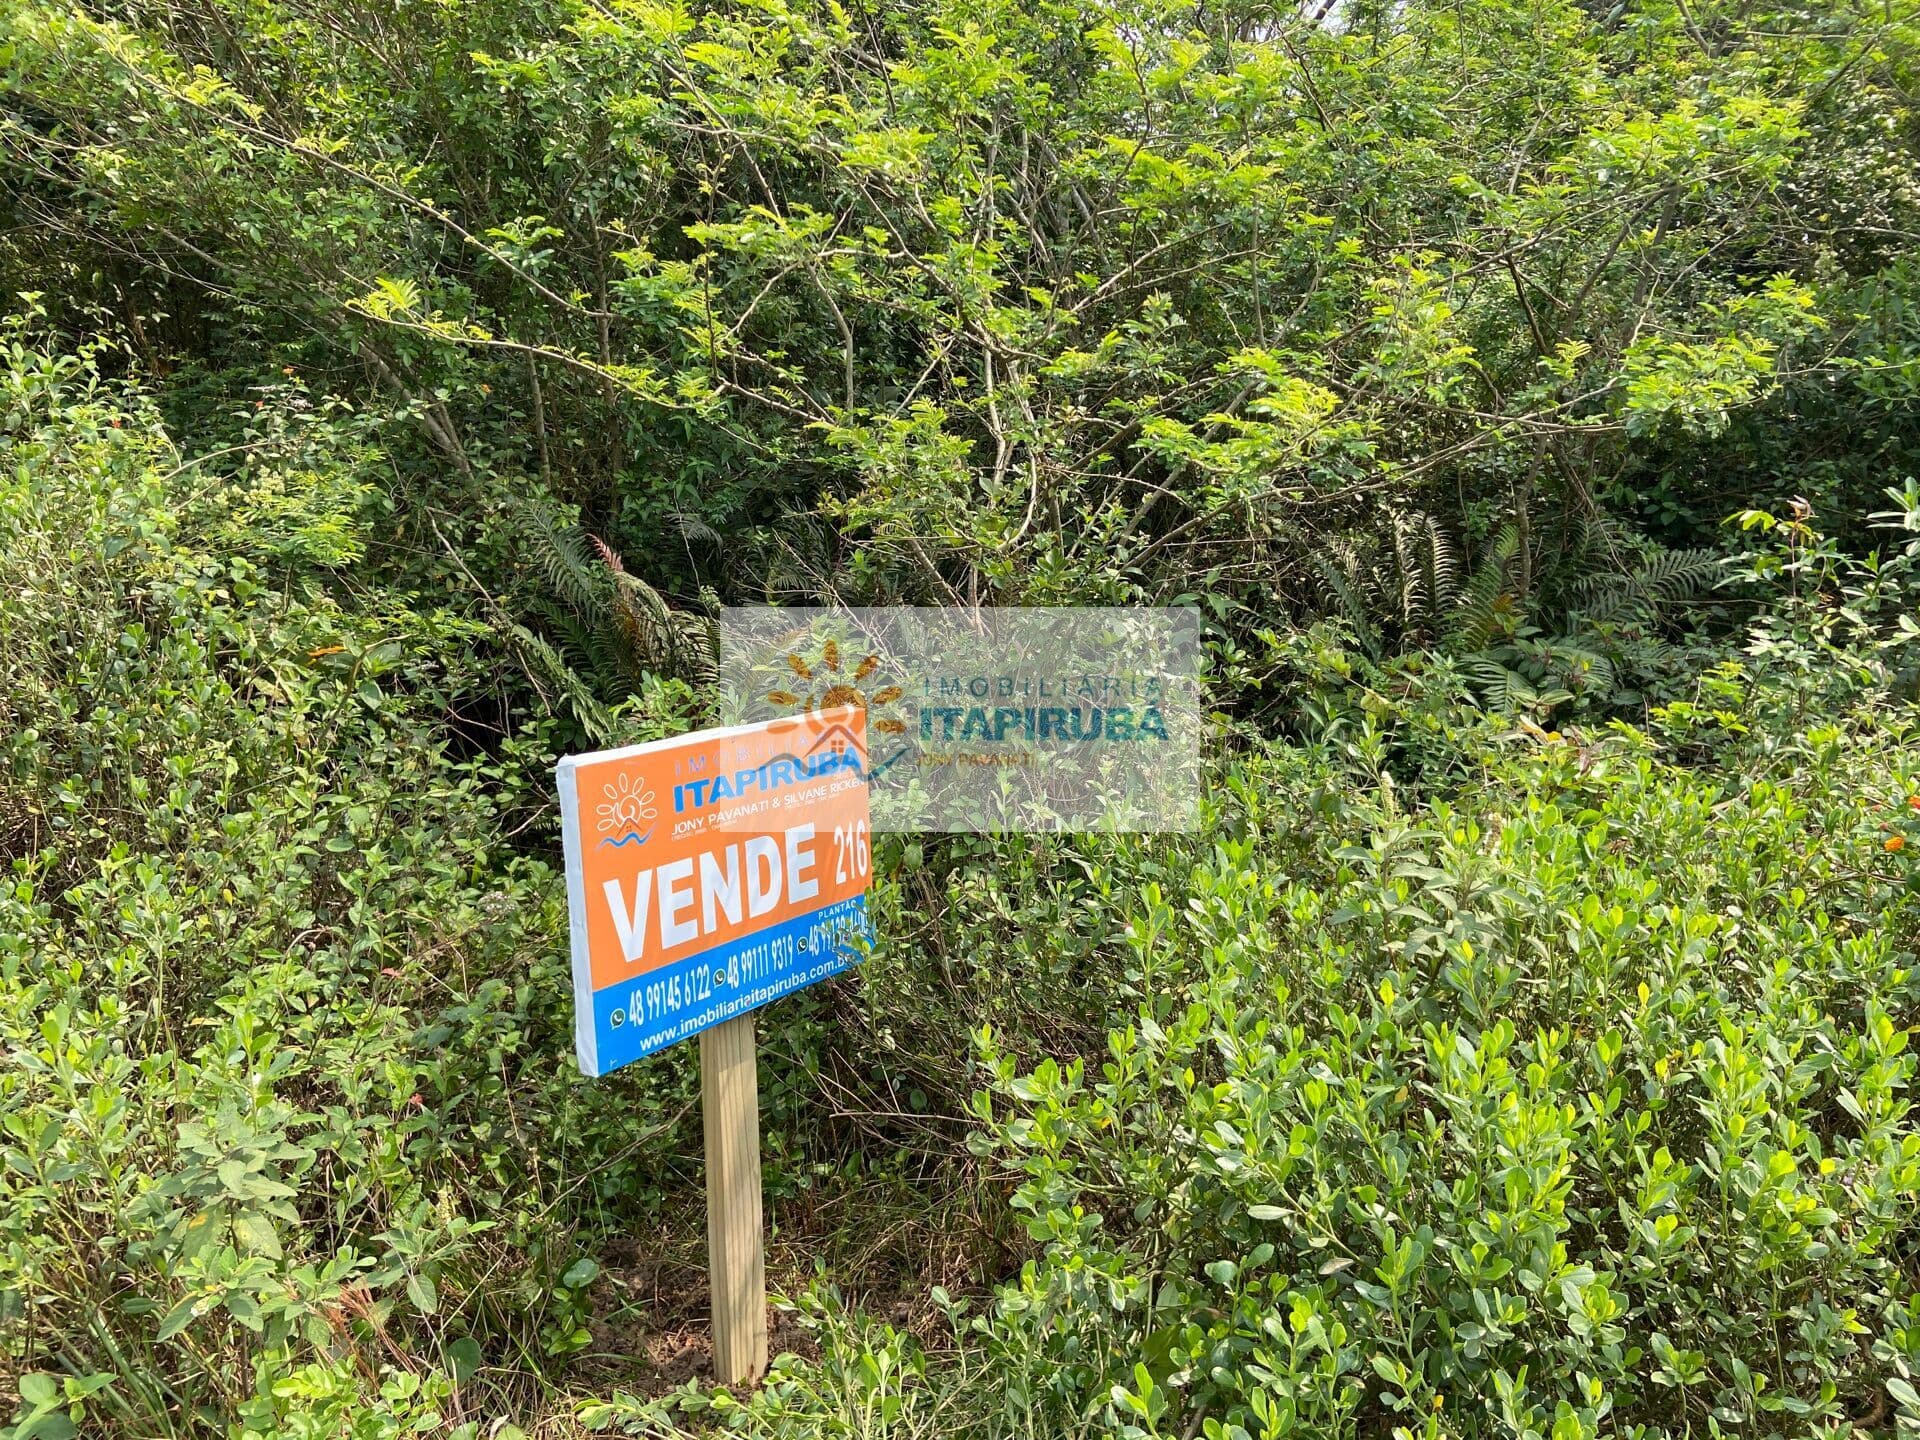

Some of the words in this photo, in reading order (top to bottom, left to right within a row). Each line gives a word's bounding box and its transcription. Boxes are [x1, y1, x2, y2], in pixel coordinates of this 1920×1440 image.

[671, 817, 704, 836] JONY
[708, 800, 769, 826] PAVANATI
[772, 797, 780, 809] &
[784, 785, 828, 807] SILVANE
[834, 820, 868, 885] 216
[602, 822, 819, 963] VENDE
[727, 954, 739, 990] 48
[741, 943, 769, 983] 99111
[771, 934, 794, 972] 9319
[629, 989, 644, 1027] 48
[646, 975, 681, 1021] 99145
[684, 963, 711, 1007] 6122
